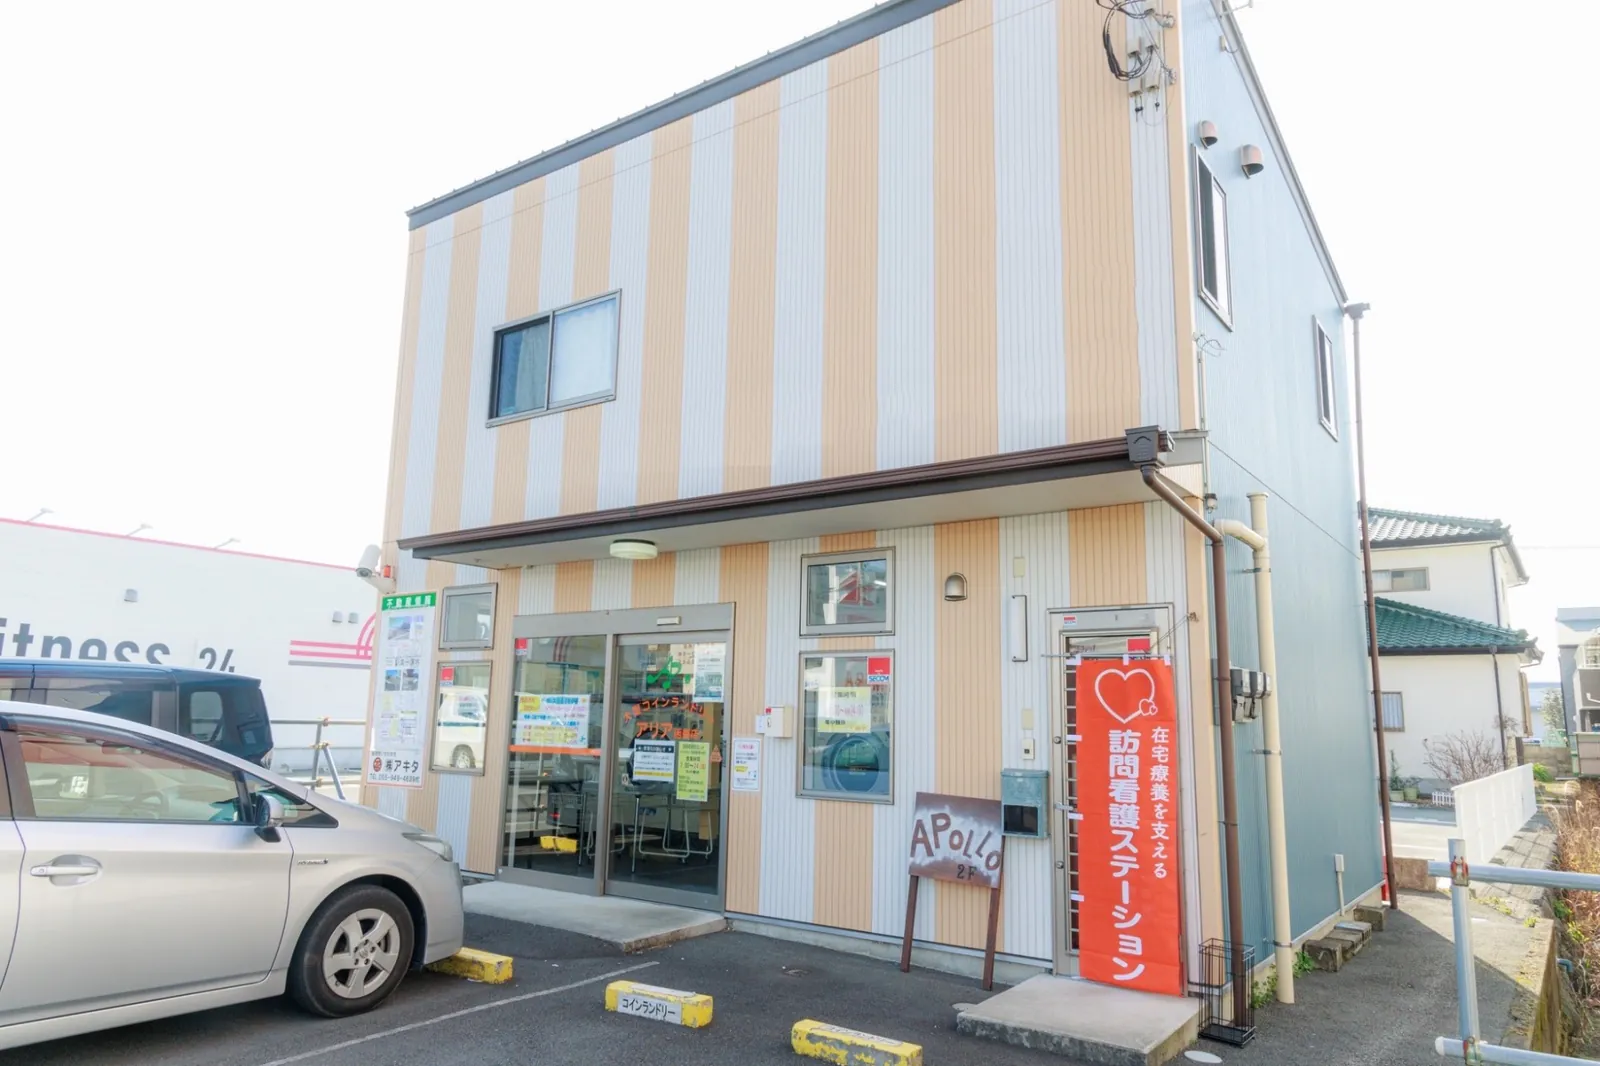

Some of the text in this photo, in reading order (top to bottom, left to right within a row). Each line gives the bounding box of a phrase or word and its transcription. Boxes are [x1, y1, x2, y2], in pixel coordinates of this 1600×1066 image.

[1150, 725, 1170, 880] 在宅療養を支える
[956, 863, 977, 881] 2F
[1109, 729, 1145, 981] 訪問看護ステーション
[621, 998, 676, 1019] コインランドリー
